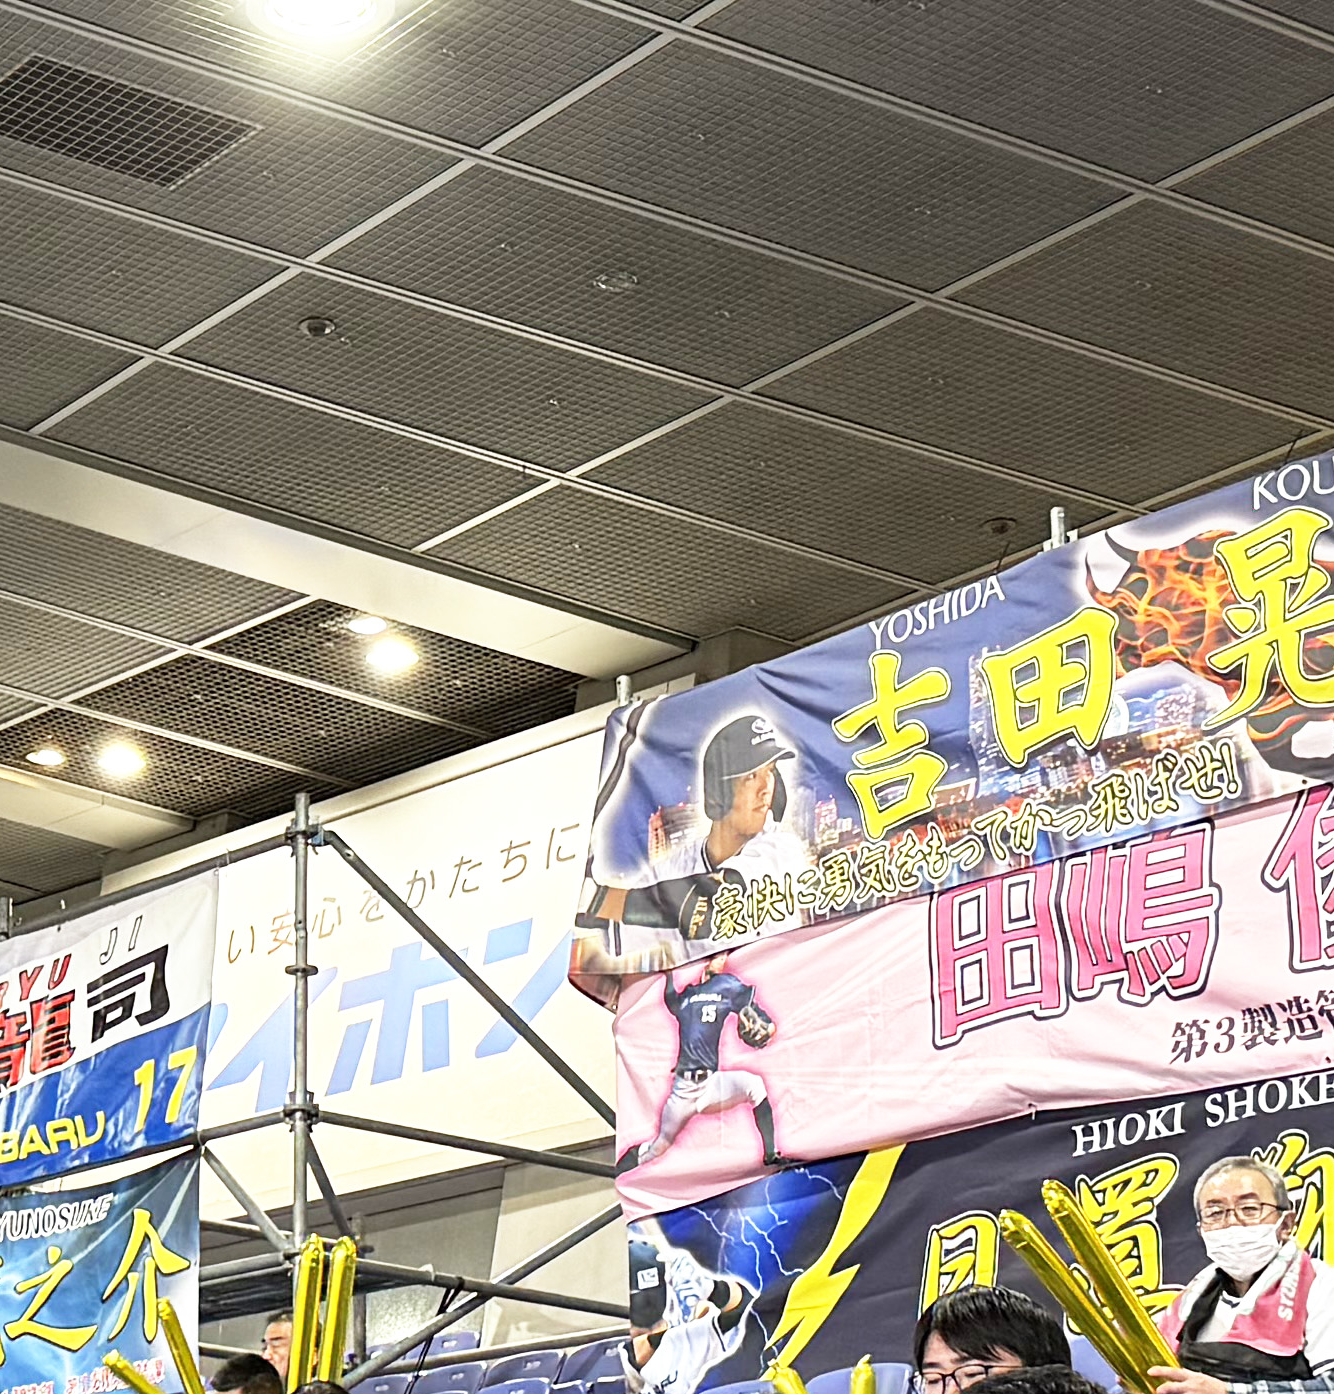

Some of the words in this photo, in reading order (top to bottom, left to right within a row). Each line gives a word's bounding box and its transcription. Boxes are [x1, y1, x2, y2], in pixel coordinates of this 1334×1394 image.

[867, 575, 1006, 649] YOSHIDA
[832, 605, 1119, 840] 吉田
[927, 817, 1223, 1050] 田嶋
[207, 917, 572, 1114] イホン
[134, 1044, 198, 1135] 17
[1071, 1102, 1186, 1157] HIOKI
